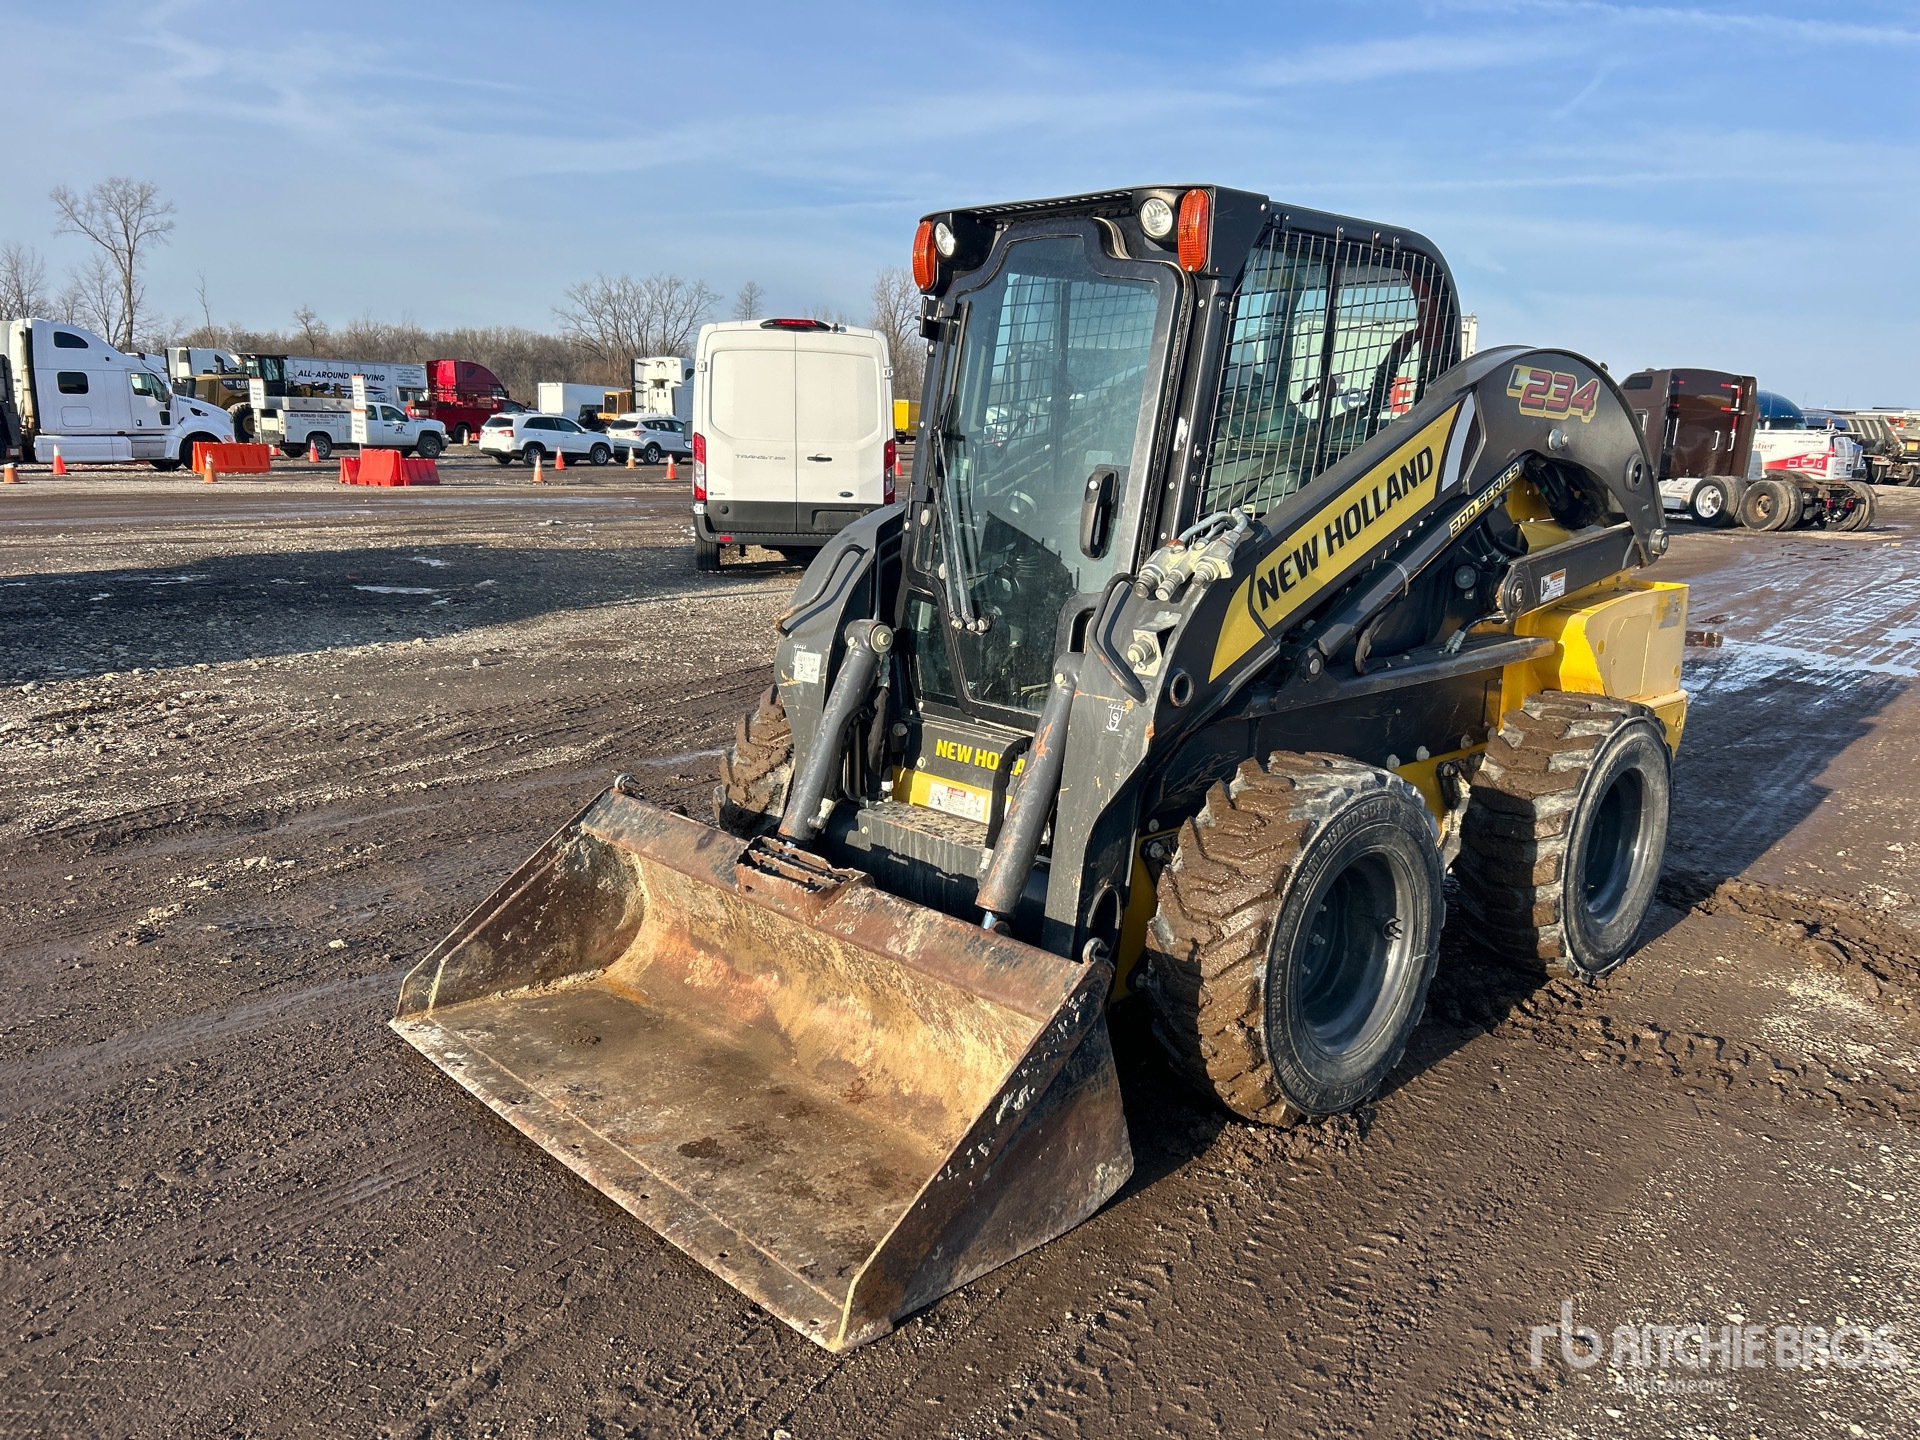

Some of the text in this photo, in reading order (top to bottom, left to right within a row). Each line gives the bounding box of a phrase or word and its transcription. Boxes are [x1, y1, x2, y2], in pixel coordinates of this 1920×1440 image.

[235, 380, 249, 389] CAT
[297, 369, 350, 380] ALL-AROUND
[1508, 366, 1600, 421] L234
[1451, 463, 1521, 537] 200 SERIES
[1257, 446, 1433, 611] NEW HOLLAND
[935, 739, 973, 764] NEW
[1319, 811, 1360, 855] GUARD
